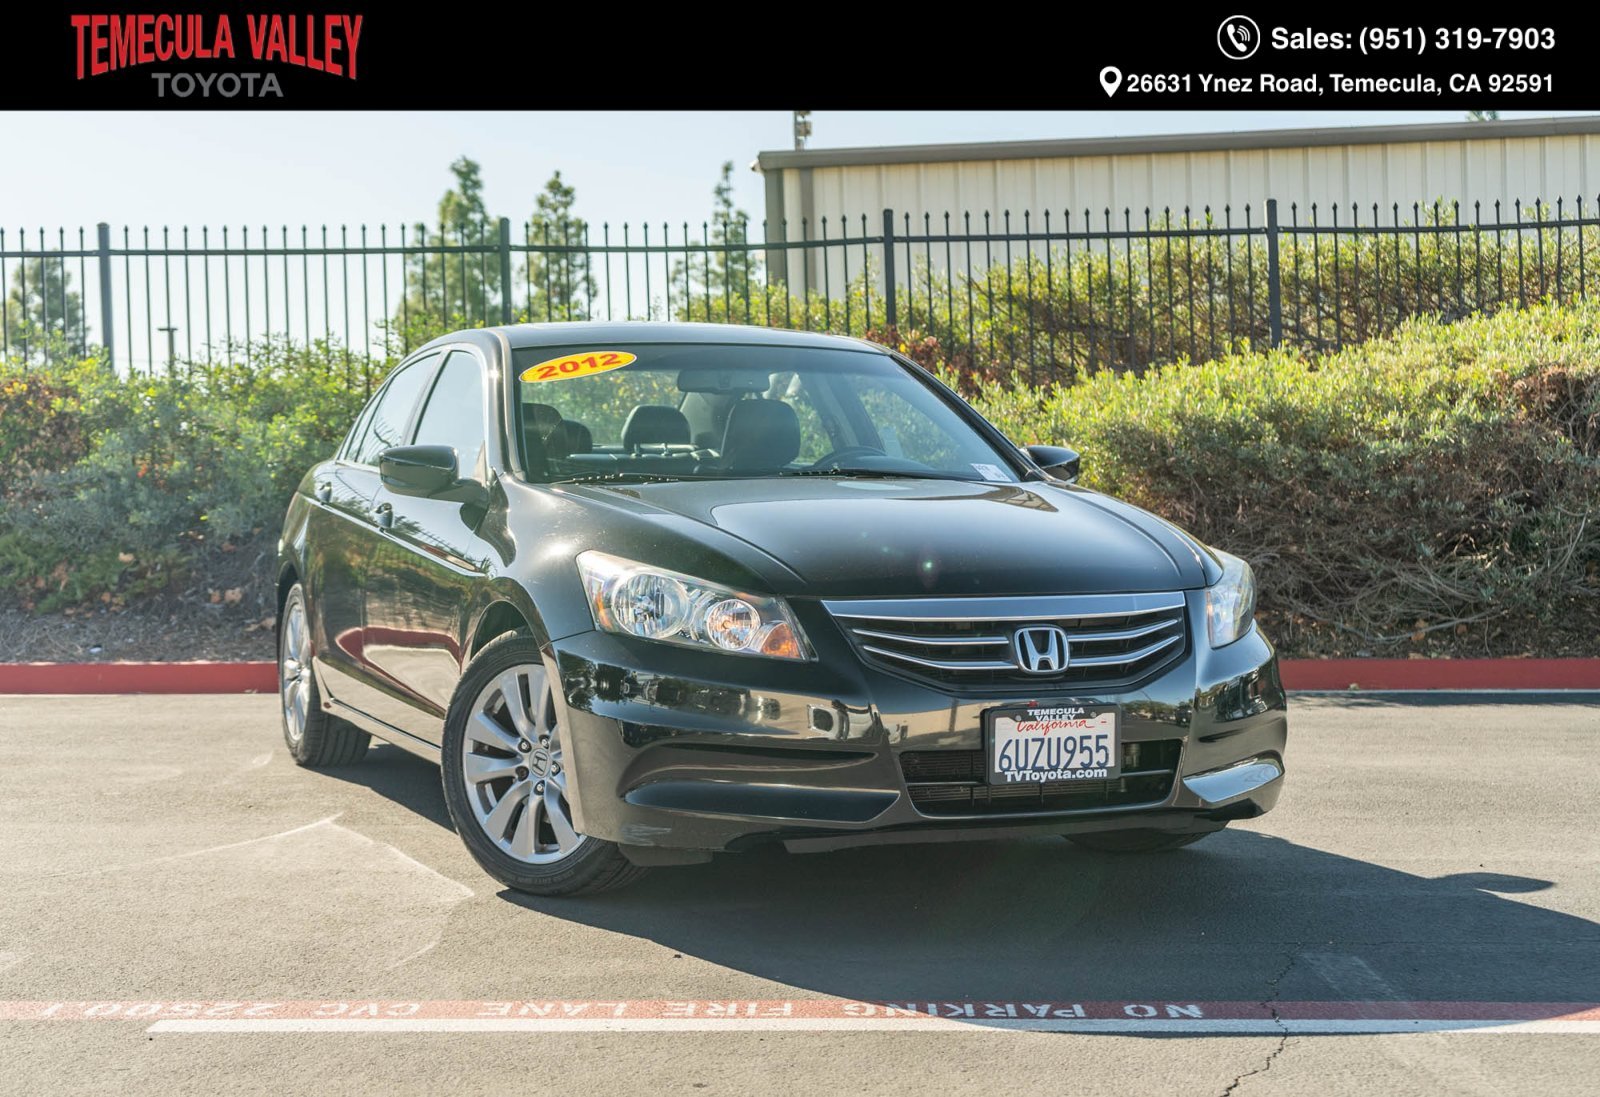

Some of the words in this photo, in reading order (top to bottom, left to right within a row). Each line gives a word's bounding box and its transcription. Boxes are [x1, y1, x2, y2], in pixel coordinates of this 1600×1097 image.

[537, 353, 622, 380] 2012
[1027, 707, 1085, 716] TEMECULA
[1035, 714, 1076, 722] VALLEY
[1016, 719, 1096, 736] California
[998, 734, 1109, 772] 6UZU955
[1004, 767, 1108, 783] TVToyota.com
[315, 1002, 420, 1017] CVC
[476, 1002, 628, 1017] LANE
[661, 1003, 794, 1017] FIRE
[842, 1003, 1086, 1019] PARKING
[1123, 1004, 1204, 1019] NO
